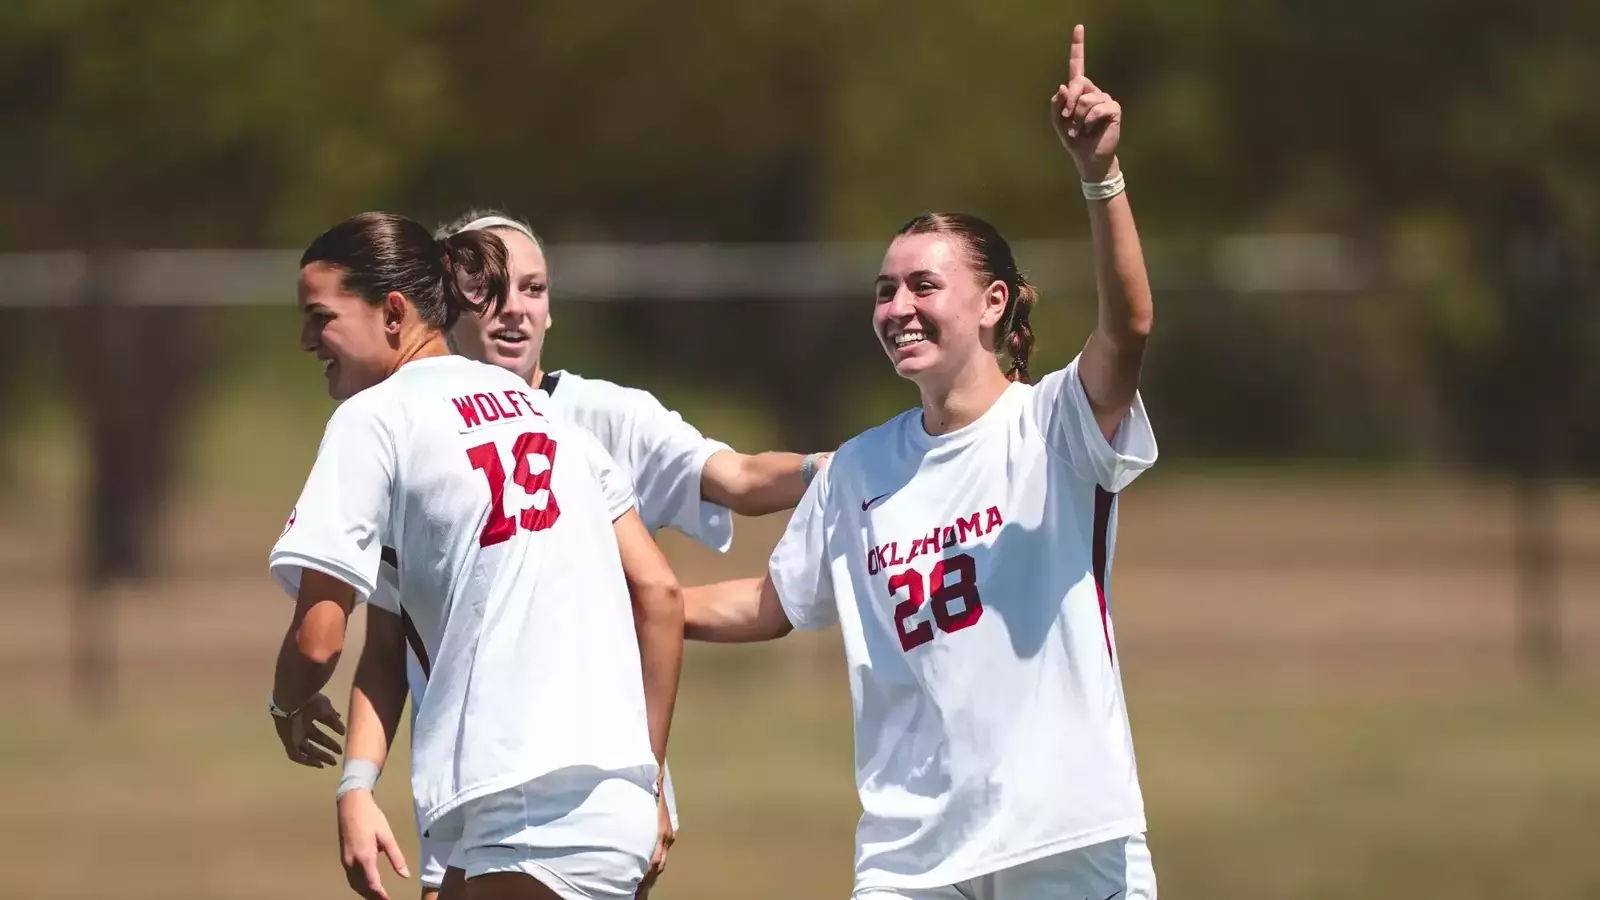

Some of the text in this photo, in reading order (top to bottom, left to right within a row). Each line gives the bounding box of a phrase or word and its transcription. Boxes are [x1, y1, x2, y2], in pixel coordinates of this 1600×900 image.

[466, 432, 561, 549] 19
[867, 505, 1003, 576] OKLAHOMA
[888, 553, 984, 653] 28
